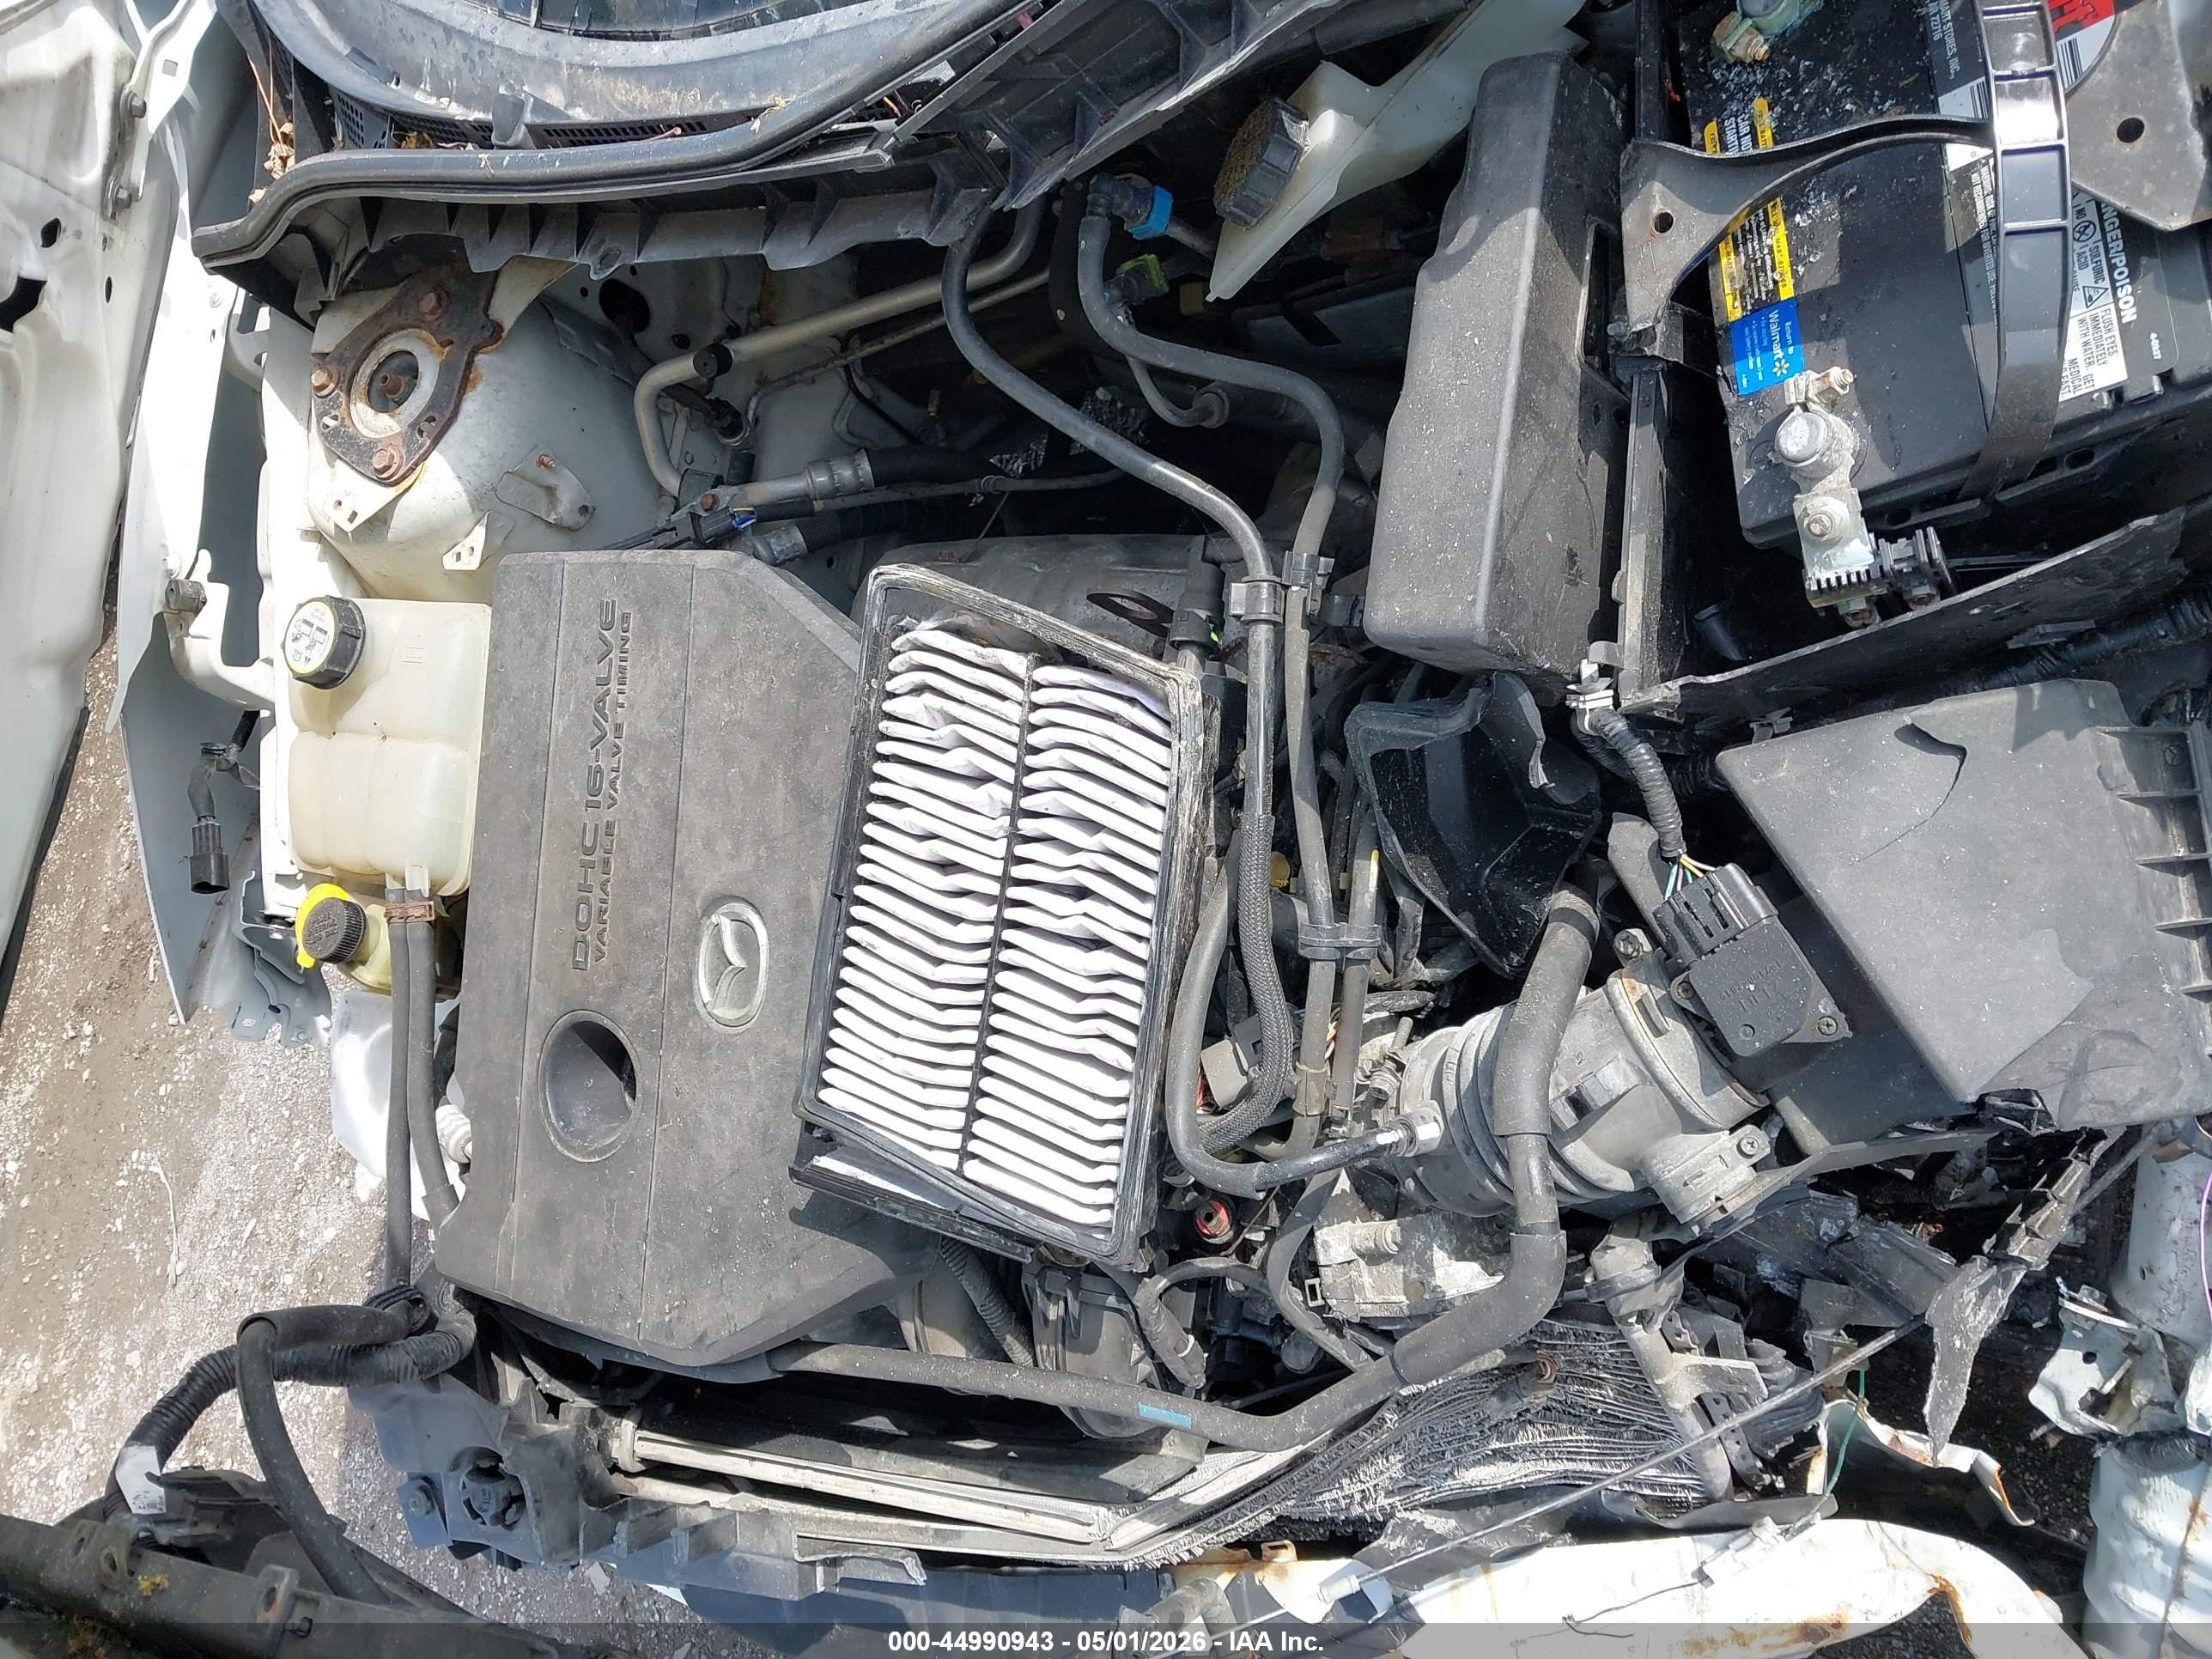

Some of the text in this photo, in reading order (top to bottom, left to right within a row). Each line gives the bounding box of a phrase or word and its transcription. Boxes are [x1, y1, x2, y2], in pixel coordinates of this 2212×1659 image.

[1929, 14, 1943, 41] 72716
[1737, 112, 1750, 136] CAR
[1972, 184, 1989, 230] RECOMMENDED
[2075, 207, 2087, 220] NO
[1980, 228, 1990, 242] FOR
[2076, 251, 2089, 271] ACID
[2088, 243, 2106, 285] SULFURIC
[2100, 203, 2137, 324] NGER/POISON
[1769, 309, 1784, 361] Walmart
[1788, 346, 1794, 355] to
[2077, 316, 2096, 371] WITH WATER.
[2088, 312, 2109, 367] IMMEDIATELY
[2100, 307, 2118, 357] FLUSH EYES
[2068, 357, 2083, 395] MEDICAL
[2082, 374, 2095, 390] GET
[572, 599, 617, 971] DOHC 16-VALVE
[595, 611, 632, 963] VARIABLE VALVE TIMING
